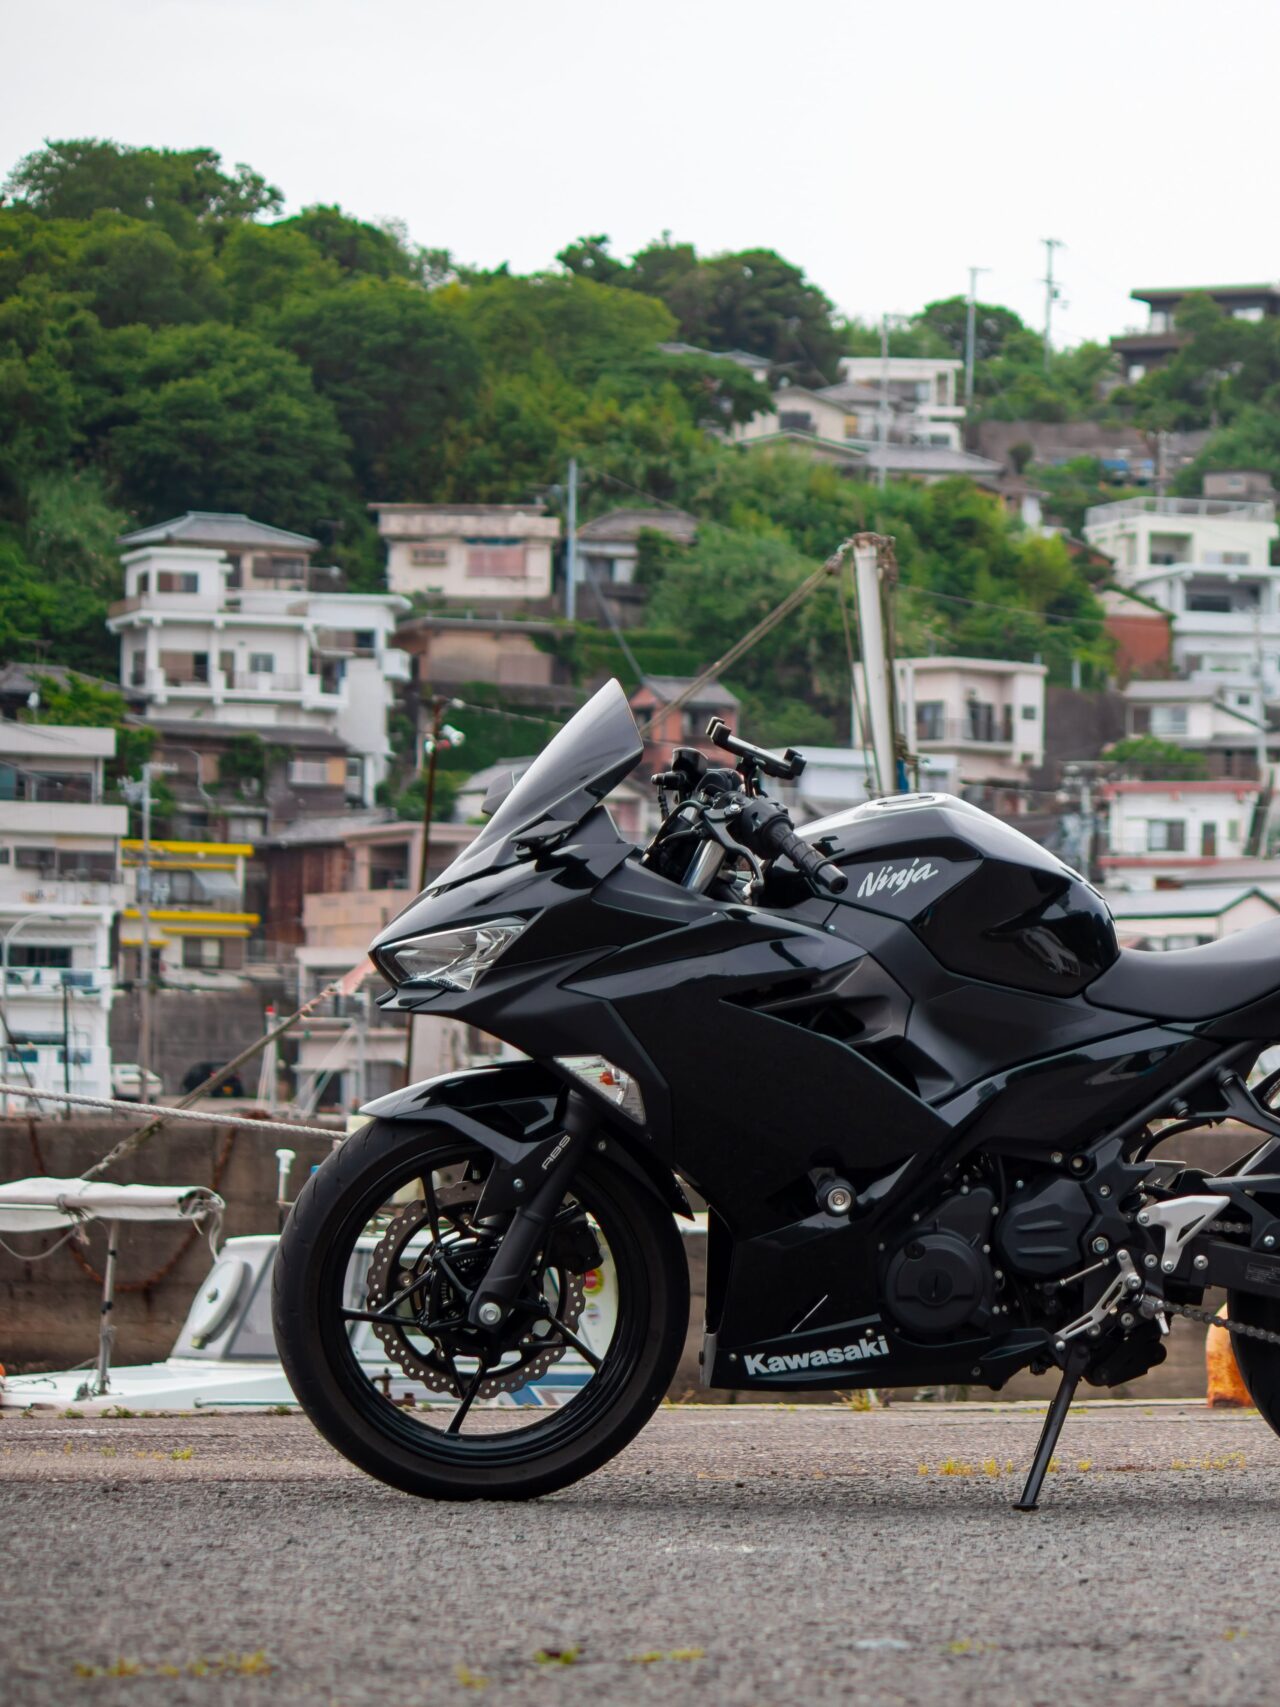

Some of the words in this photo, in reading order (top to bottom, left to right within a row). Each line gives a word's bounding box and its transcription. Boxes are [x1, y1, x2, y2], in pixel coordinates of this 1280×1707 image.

[857, 857, 939, 898] Ninja
[541, 1134, 571, 1170] ABS
[743, 1335, 890, 1376] Kawasaki
